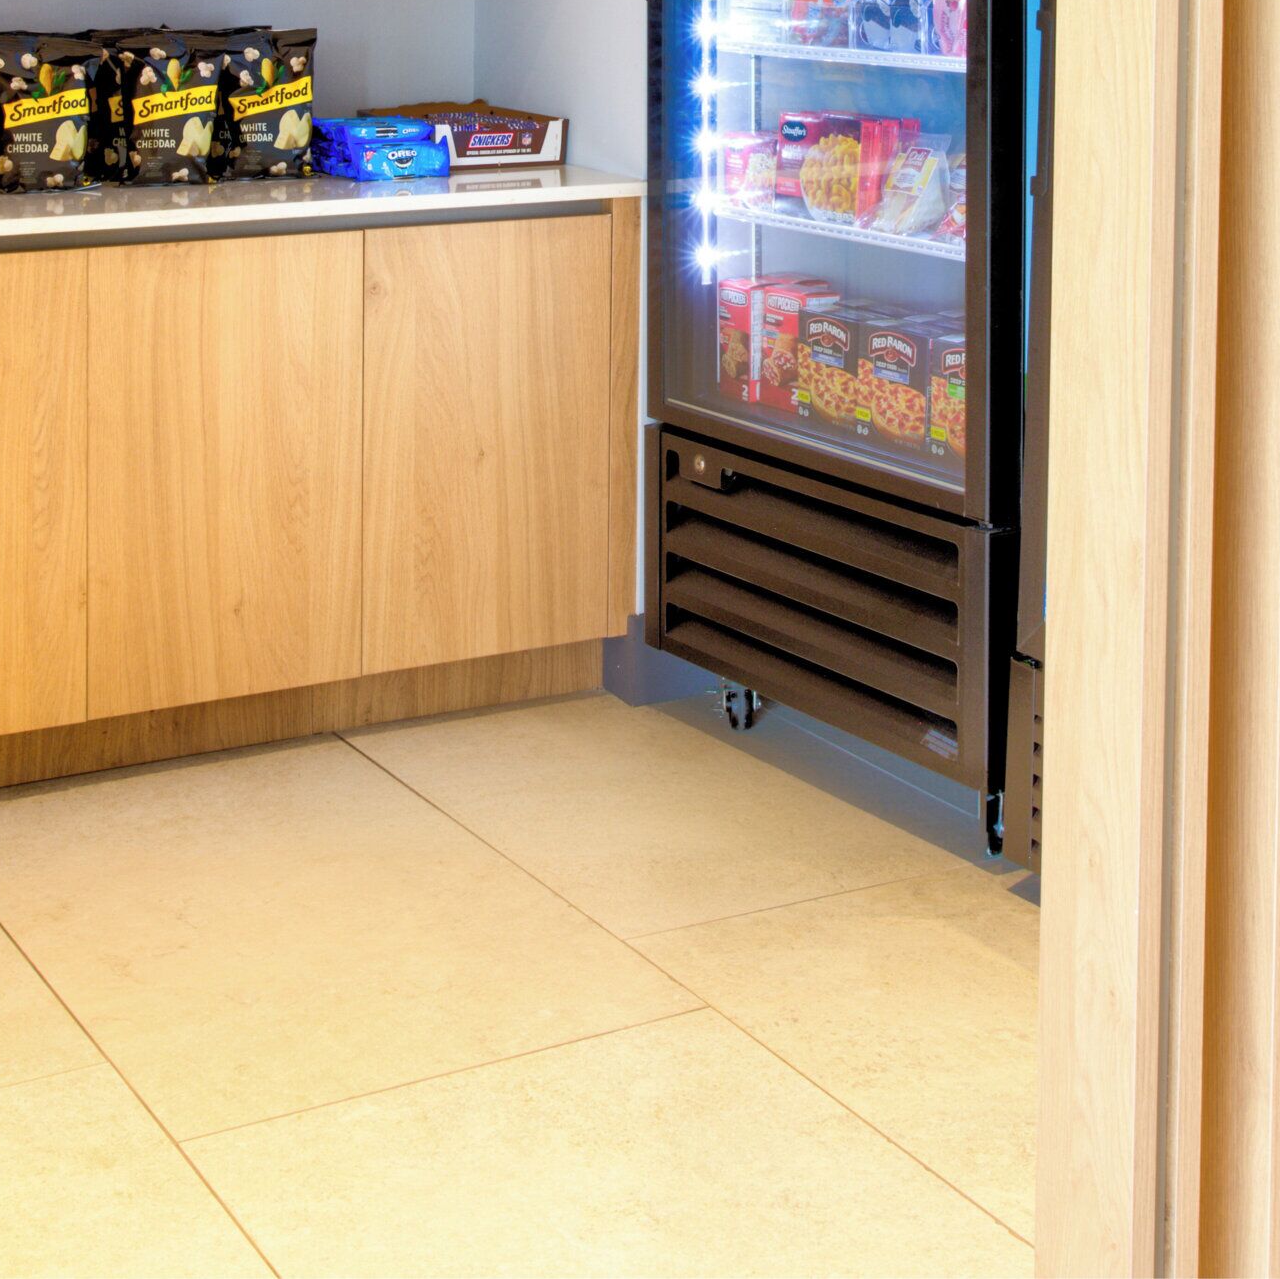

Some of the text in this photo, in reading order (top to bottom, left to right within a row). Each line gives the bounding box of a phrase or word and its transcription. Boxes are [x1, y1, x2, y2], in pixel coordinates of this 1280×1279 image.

[237, 83, 308, 114] Smartfood
[10, 94, 87, 121] Smartfood
[139, 93, 213, 118] Smartfood
[240, 122, 267, 131] WHITE
[782, 125, 806, 136] Stouffer's
[13, 133, 42, 142] WHITE
[142, 128, 169, 138] WHITE
[136, 139, 175, 148] CHEDDAR
[471, 135, 511, 146] SNICKERS
[7, 144, 48, 153] CHEDDAR
[388, 150, 417, 160] OREO
[810, 322, 846, 343] RED BARON
[872, 336, 912, 358] RED BARON
[946, 354, 960, 367] RED
[742, 385, 748, 396] 2
